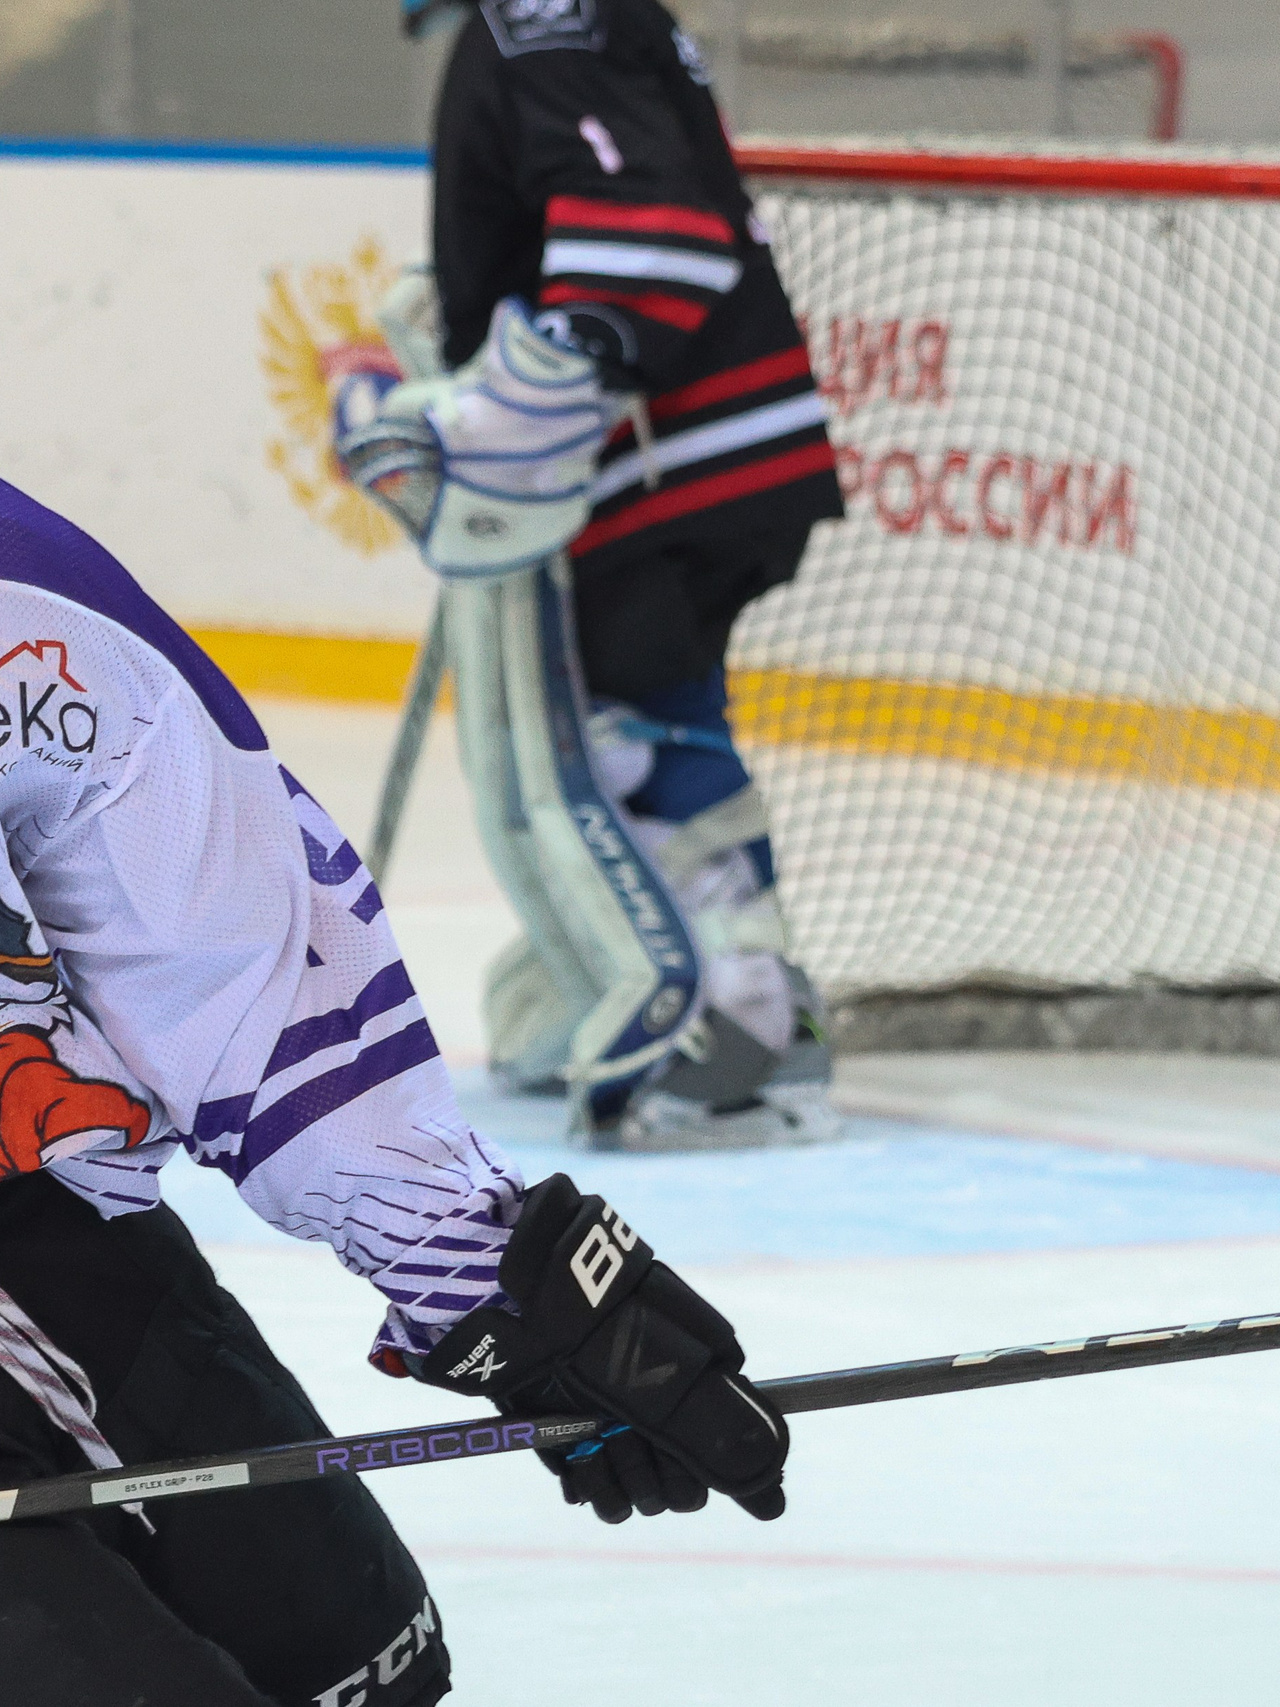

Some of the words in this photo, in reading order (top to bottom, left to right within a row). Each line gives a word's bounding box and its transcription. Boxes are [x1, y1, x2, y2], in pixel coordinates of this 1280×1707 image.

[317, 1421, 535, 1474] RIBCOR
[538, 1421, 597, 1437] TRIGGER
[124, 1483, 138, 1493] 85
[139, 1479, 162, 1490] FLEX
[164, 1476, 187, 1487] GRIP
[195, 1473, 214, 1482] P28
[312, 1595, 436, 1707] CCM
